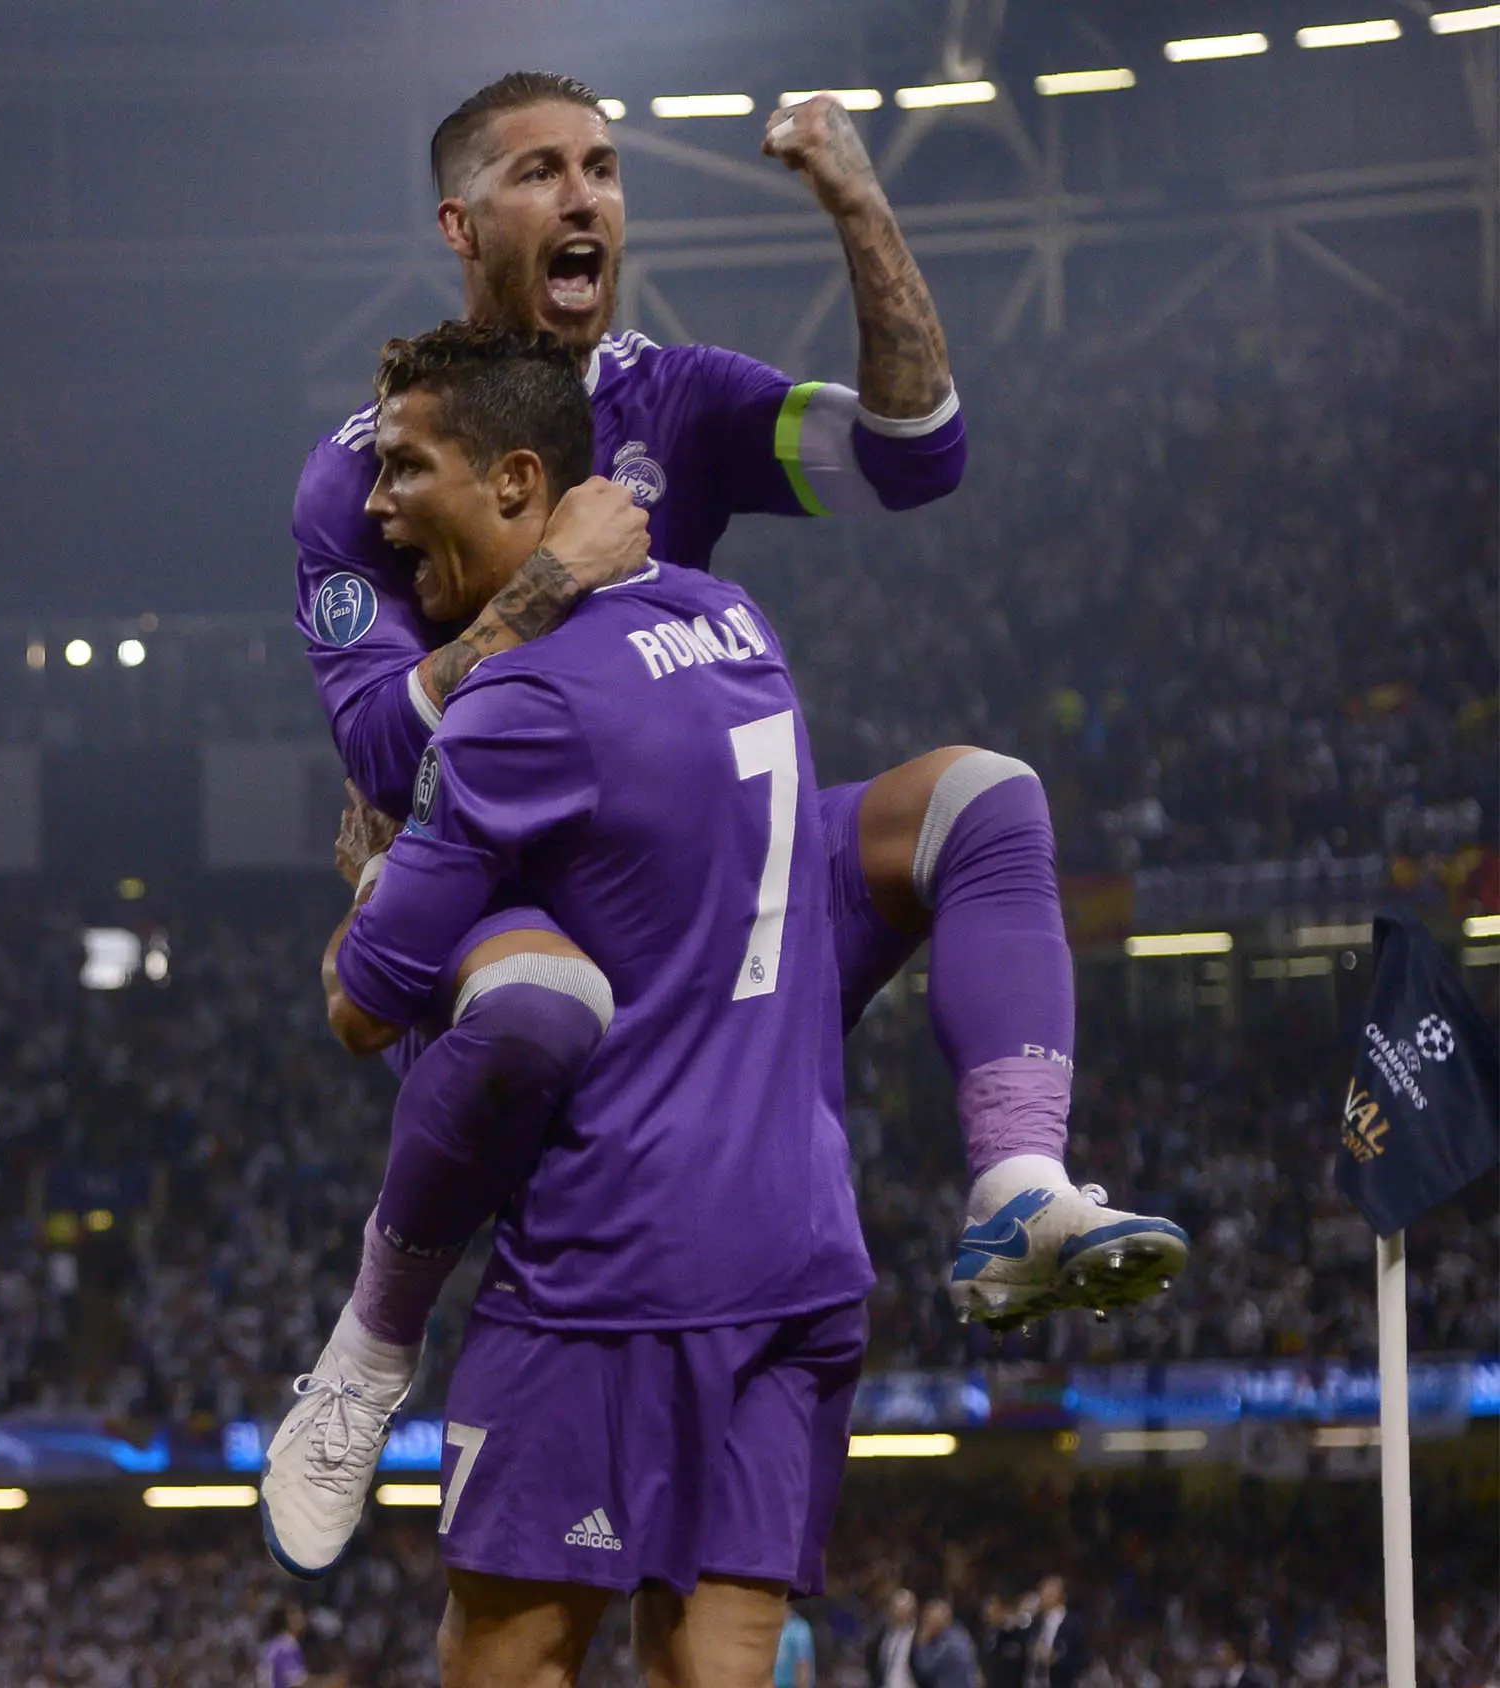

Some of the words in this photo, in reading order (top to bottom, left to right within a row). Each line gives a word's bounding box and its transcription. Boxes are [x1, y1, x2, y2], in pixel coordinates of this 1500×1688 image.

[730, 710, 799, 1001] 7
[1365, 1022, 1428, 1110] CHAMPIONS
[438, 1421, 487, 1535] 7
[564, 1530, 622, 1551] adidas
